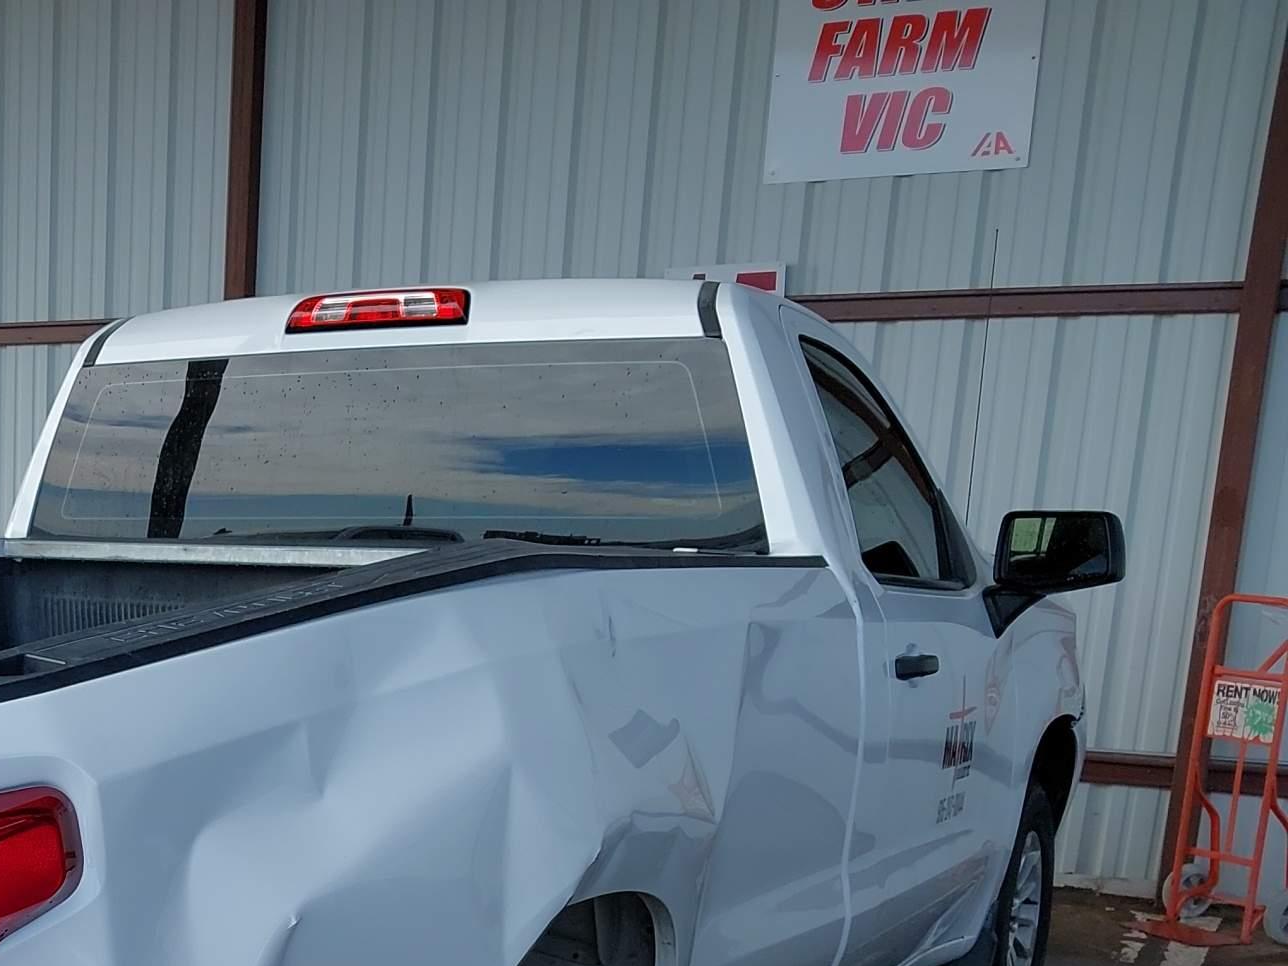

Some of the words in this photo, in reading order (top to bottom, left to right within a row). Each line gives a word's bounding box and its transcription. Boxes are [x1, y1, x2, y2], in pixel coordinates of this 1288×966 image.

[808, 8, 992, 83] FARM
[840, 87, 953, 154] VIC
[1216, 683, 1251, 699] RENT
